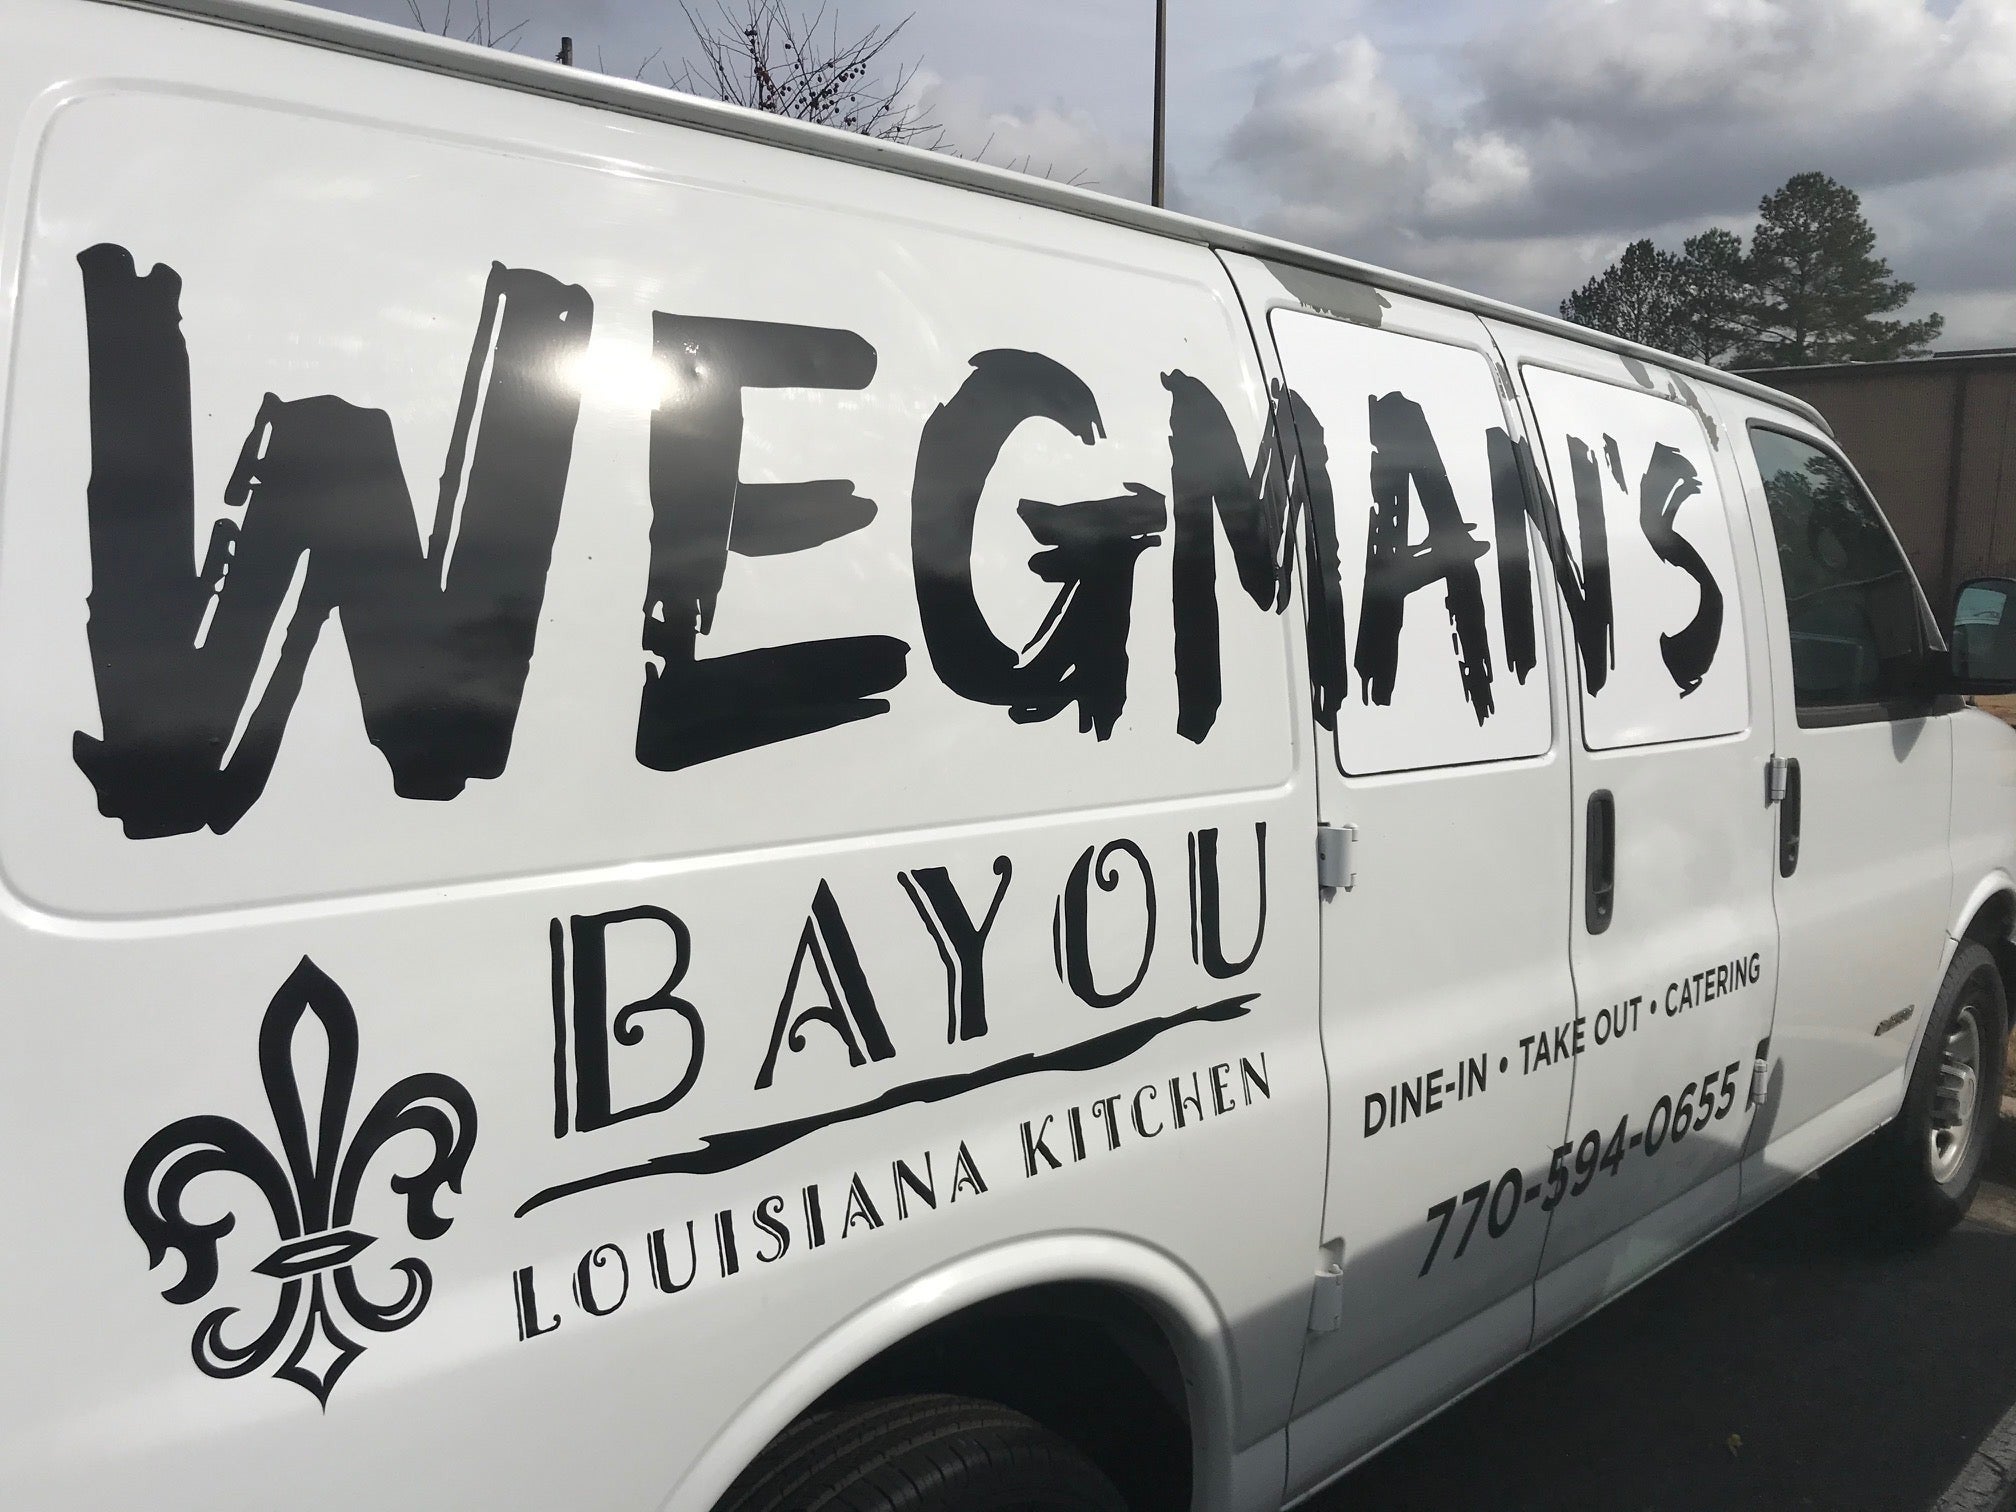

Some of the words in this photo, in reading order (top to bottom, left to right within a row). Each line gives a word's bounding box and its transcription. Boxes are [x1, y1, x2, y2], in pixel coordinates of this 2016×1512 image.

[72, 242, 1723, 840] WEGMAN'S
[550, 821, 1268, 1139] BAYOU
[1363, 1052, 1488, 1138] DINE-IN
[1519, 1016, 1586, 1076] TAKE
[1594, 995, 1643, 1045] OUT
[1664, 952, 1761, 1018] CATERING
[513, 1140, 988, 1342] LOUISIANA
[1023, 1052, 1273, 1178] KITCHEN
[1418, 1061, 1741, 1278] 770-594-0655
